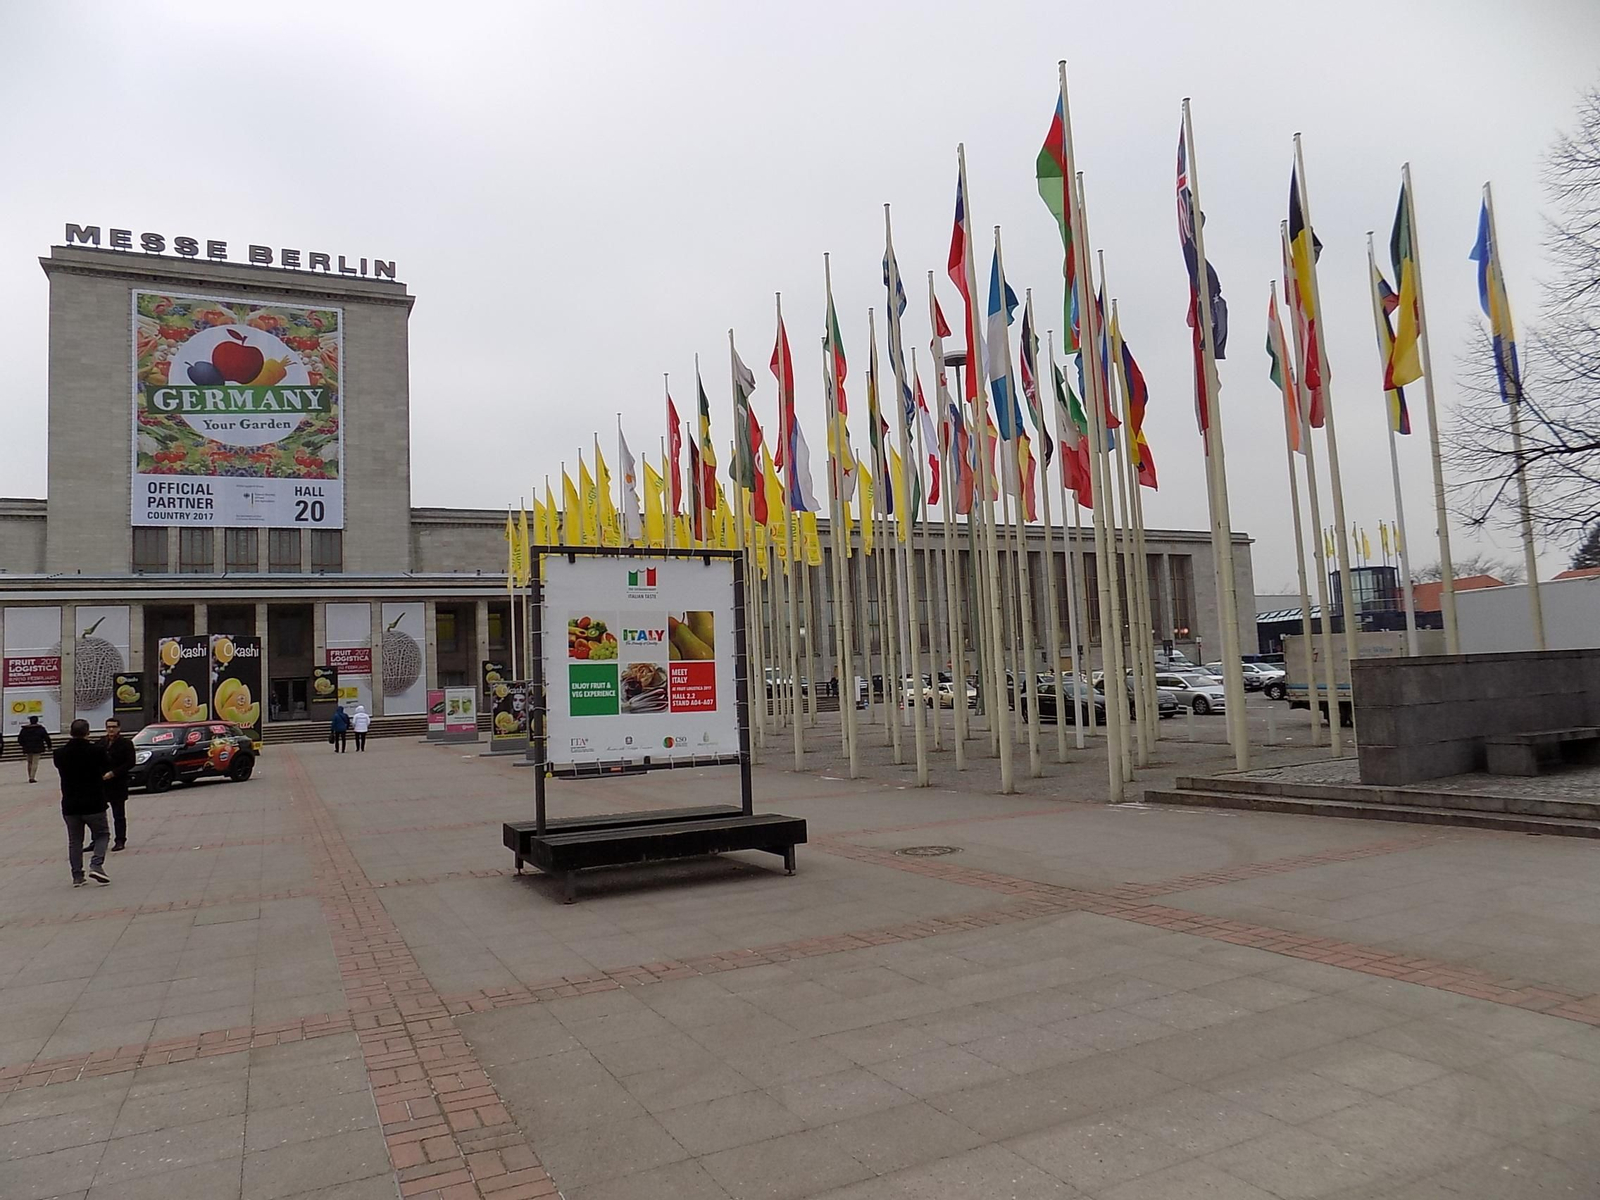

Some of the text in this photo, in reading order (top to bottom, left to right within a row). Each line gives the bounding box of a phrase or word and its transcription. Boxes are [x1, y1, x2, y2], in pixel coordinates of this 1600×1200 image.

[65, 223, 396, 278] MESSE BERLIN
[152, 388, 325, 411] GERMANY
[202, 418, 291, 431] Your Garden
[147, 481, 214, 496] OFFICIAL
[294, 486, 325, 498] HALL
[147, 496, 214, 510] PARTNER
[147, 511, 214, 521] COUNTRY 2017
[294, 499, 325, 522] 20
[623, 629, 665, 641] ITALY
[170, 643, 207, 659] Okashi
[223, 643, 259, 658] Okashi
[671, 668, 688, 676] MEET
[572, 682, 589, 690] ENJOY
[671, 676, 688, 684] ITALY
[572, 690, 616, 698] VEG EXPERIENCE
[672, 699, 690, 707] STAND
